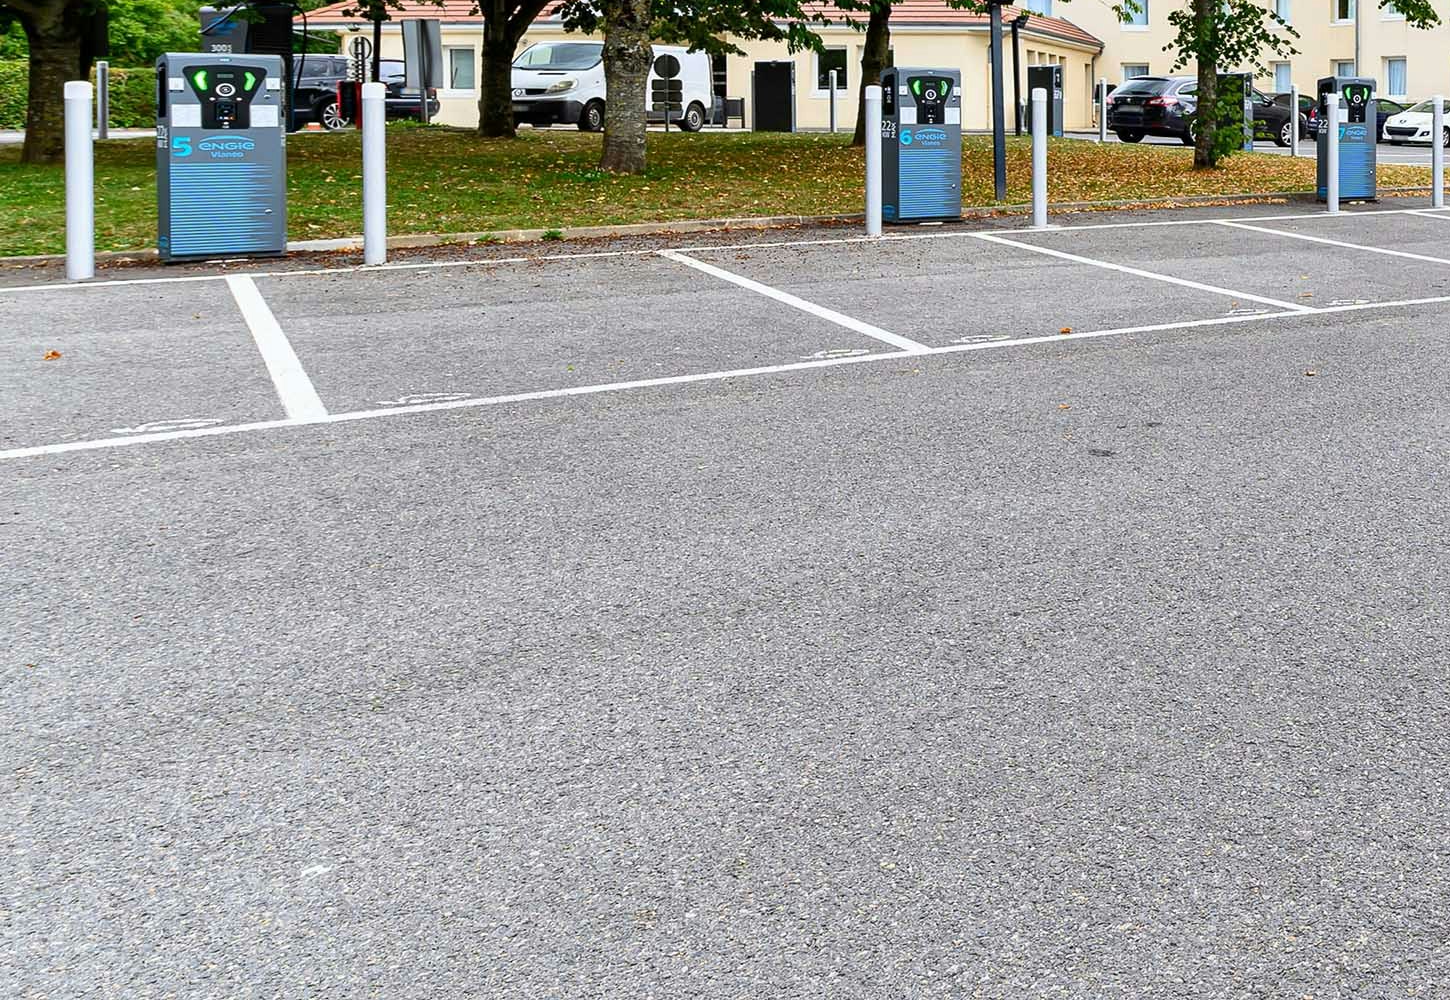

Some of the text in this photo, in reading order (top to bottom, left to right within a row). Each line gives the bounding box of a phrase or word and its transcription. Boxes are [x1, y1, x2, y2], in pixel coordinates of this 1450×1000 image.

[881, 120, 891, 131] 22
[1318, 119, 1328, 128] 22
[900, 129, 913, 145] 6
[172, 136, 192, 157] 5
